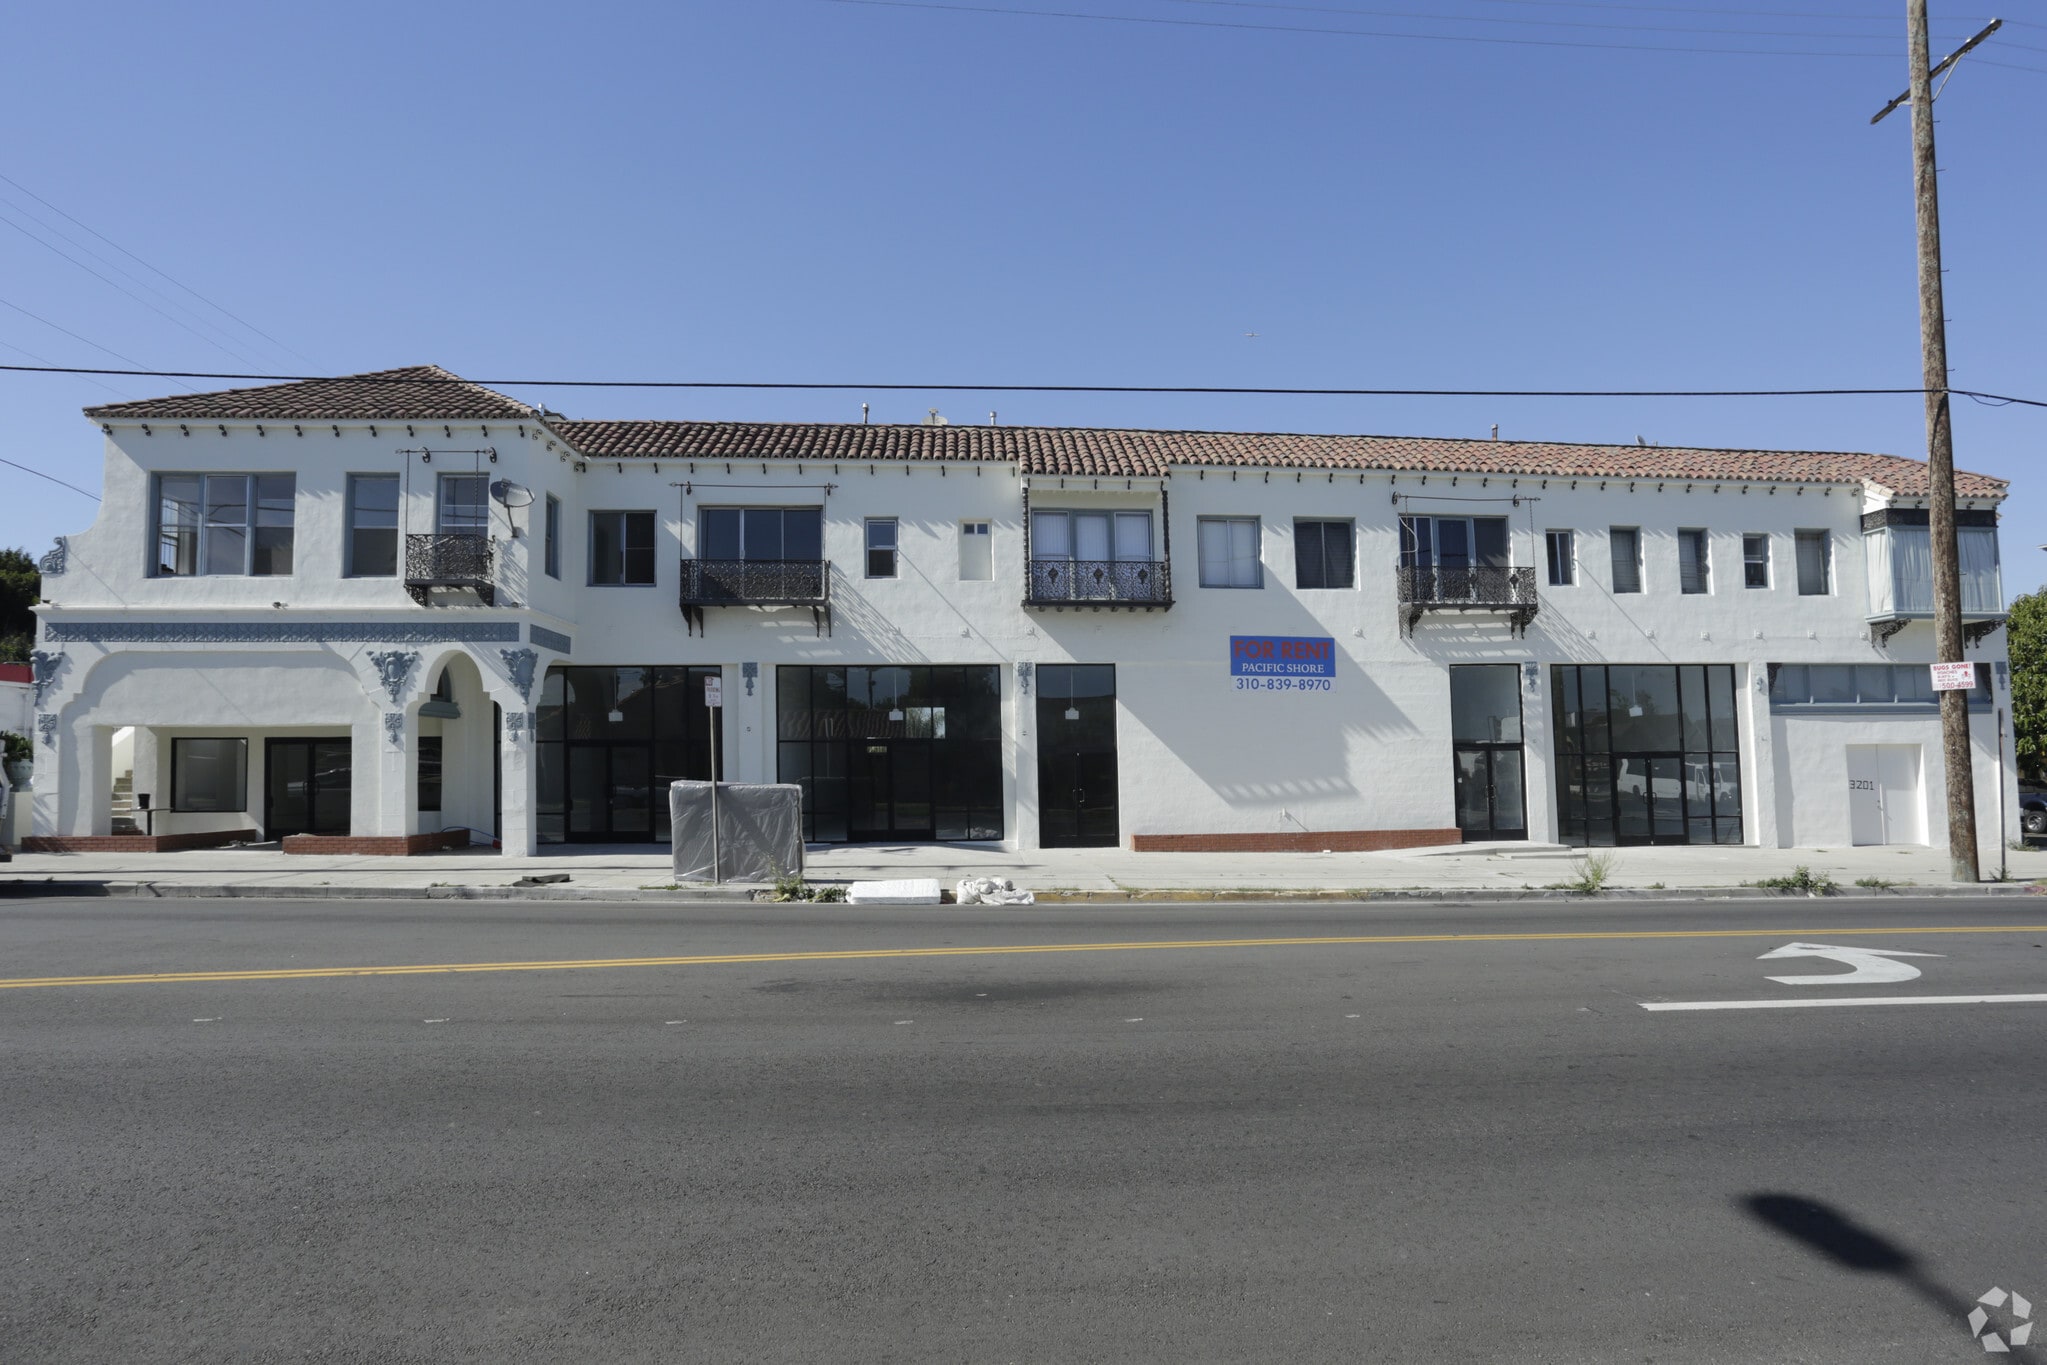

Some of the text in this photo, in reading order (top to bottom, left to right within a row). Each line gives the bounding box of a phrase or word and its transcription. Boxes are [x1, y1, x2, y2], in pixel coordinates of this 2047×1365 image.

[1234, 640, 1331, 660] FOR RENT
[1242, 662, 1325, 674] PACIFIC SHORE
[1236, 678, 1331, 691] 310-839-8970
[1849, 780, 1874, 790] 3201
